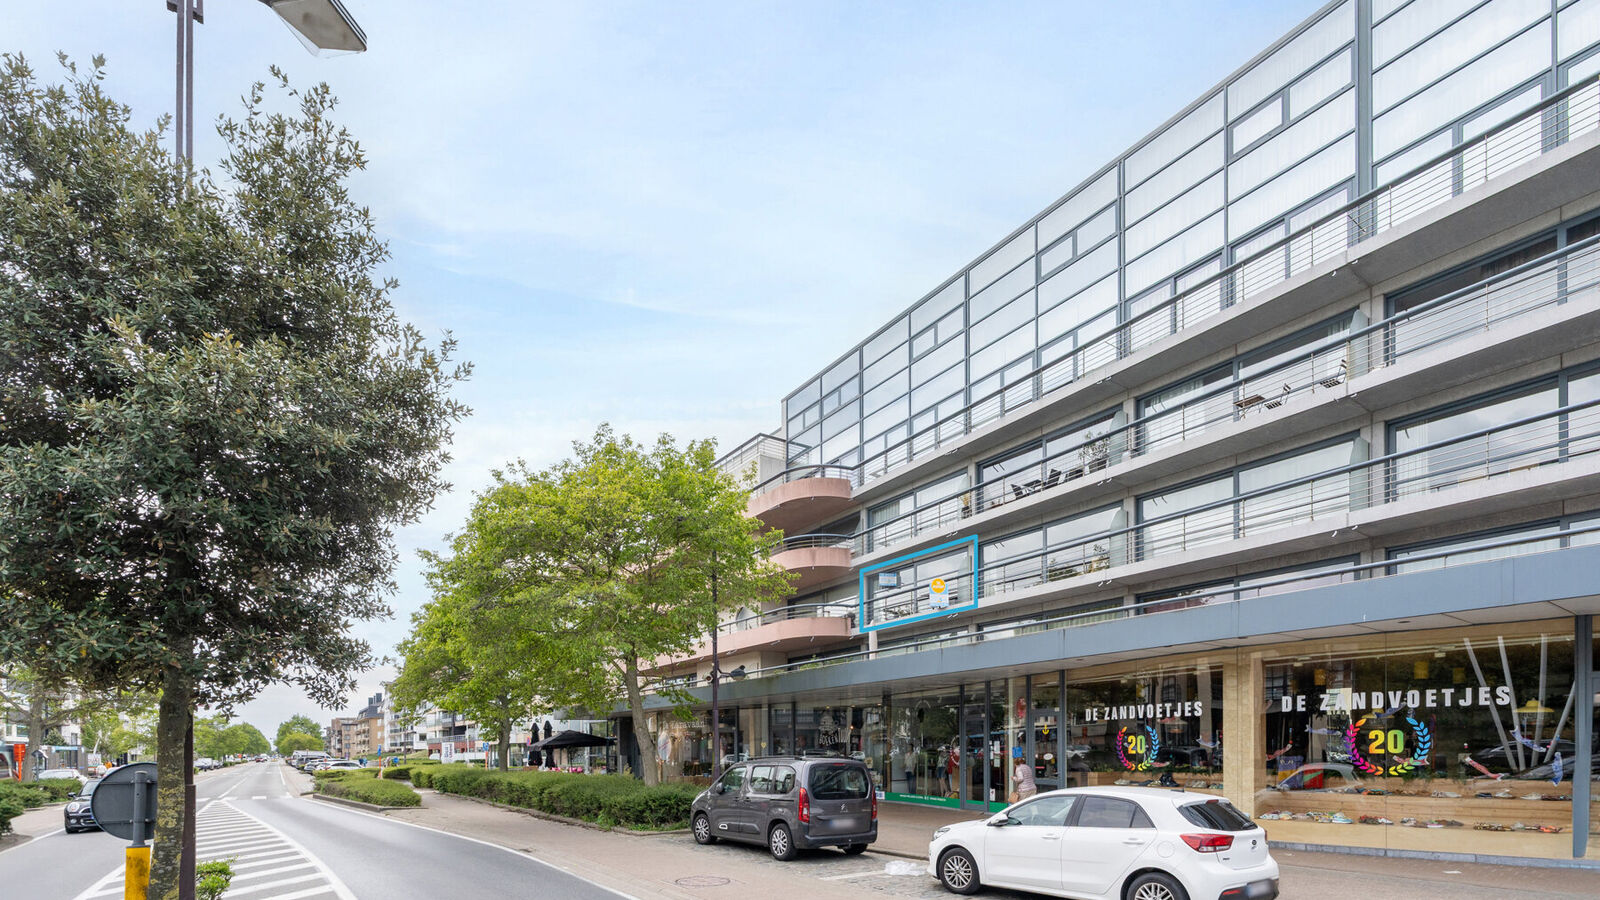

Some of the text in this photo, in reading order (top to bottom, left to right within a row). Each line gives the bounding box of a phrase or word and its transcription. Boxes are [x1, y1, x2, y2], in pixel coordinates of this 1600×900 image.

[1281, 686, 1511, 713] DE ZANDVOETJES
[1085, 701, 1203, 721] DE ZANDVOETJES
[1127, 735, 1145, 754] 20
[1368, 729, 1404, 754] 20
